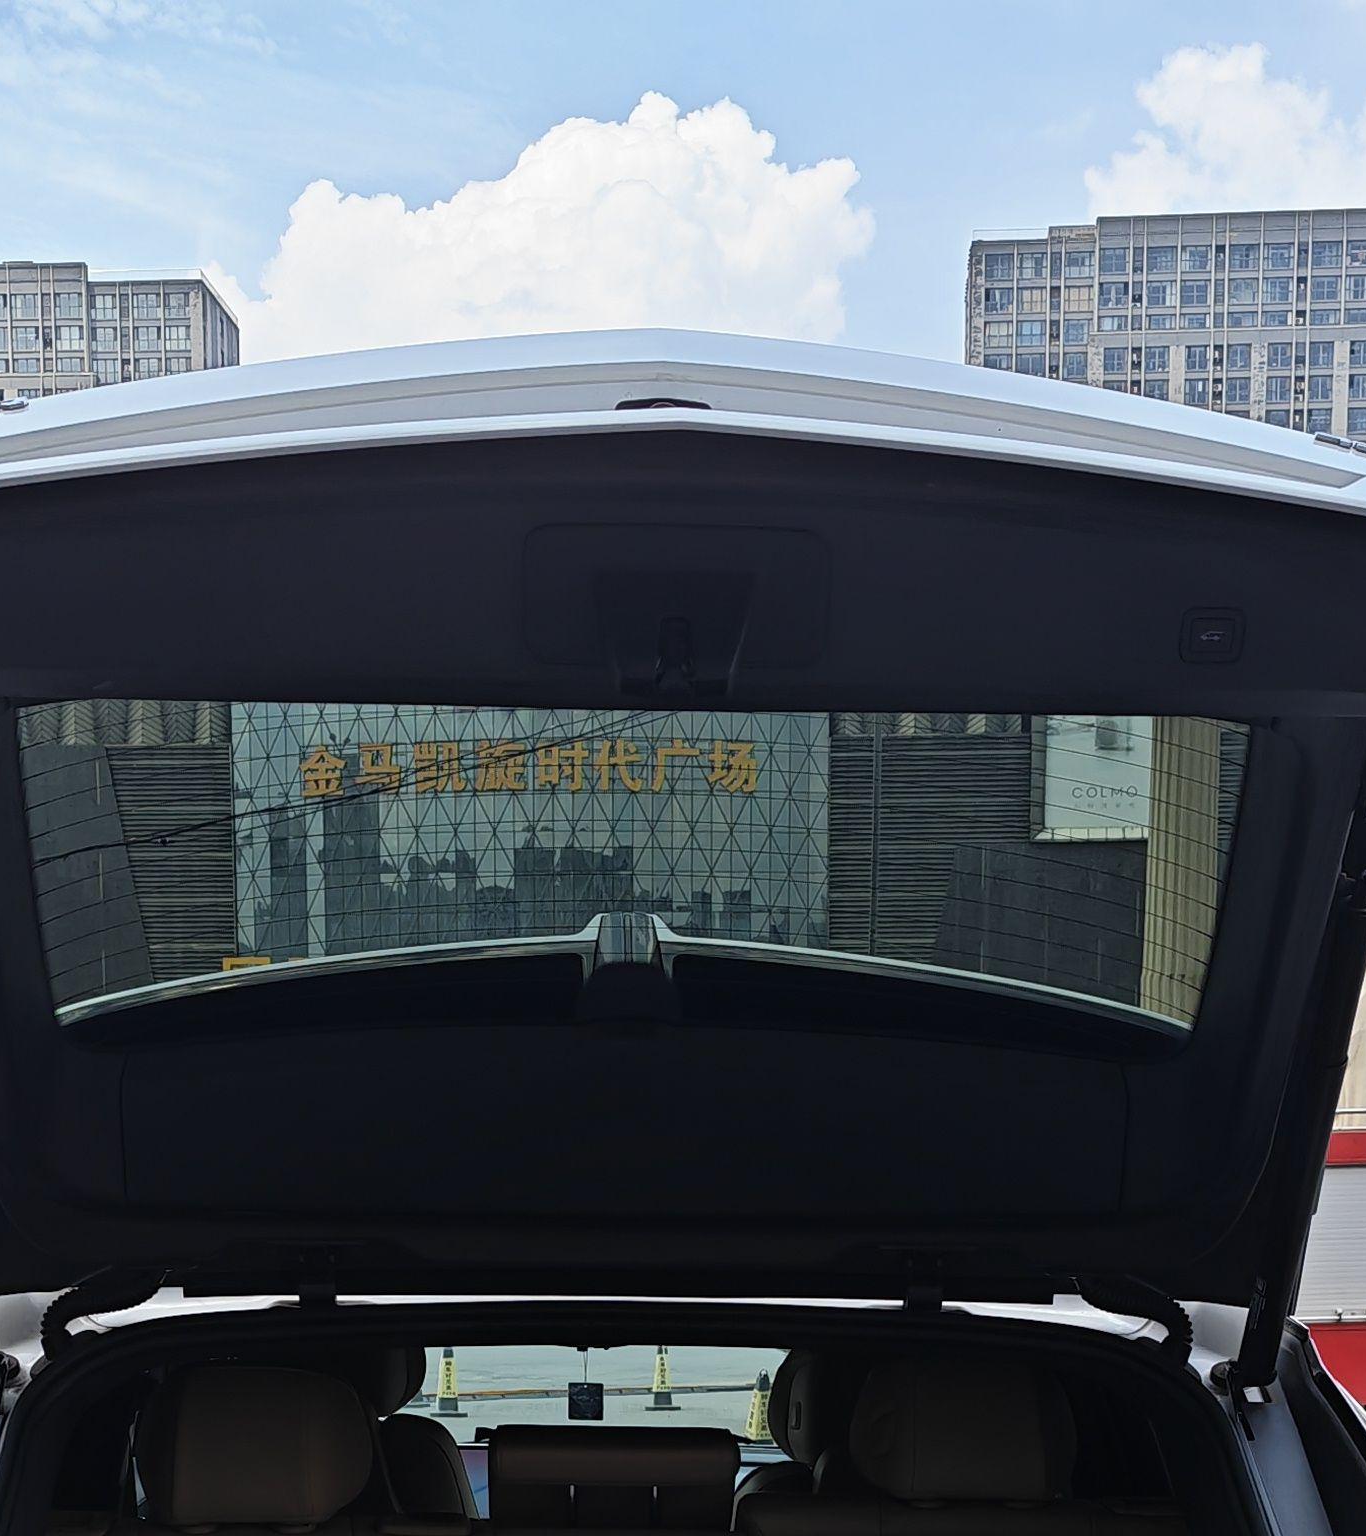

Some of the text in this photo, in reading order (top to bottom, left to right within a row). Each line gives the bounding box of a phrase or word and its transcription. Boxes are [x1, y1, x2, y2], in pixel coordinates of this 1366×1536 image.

[300, 739, 759, 797] 金马凯旋时代广场
[1071, 785, 1138, 799] COLMO
